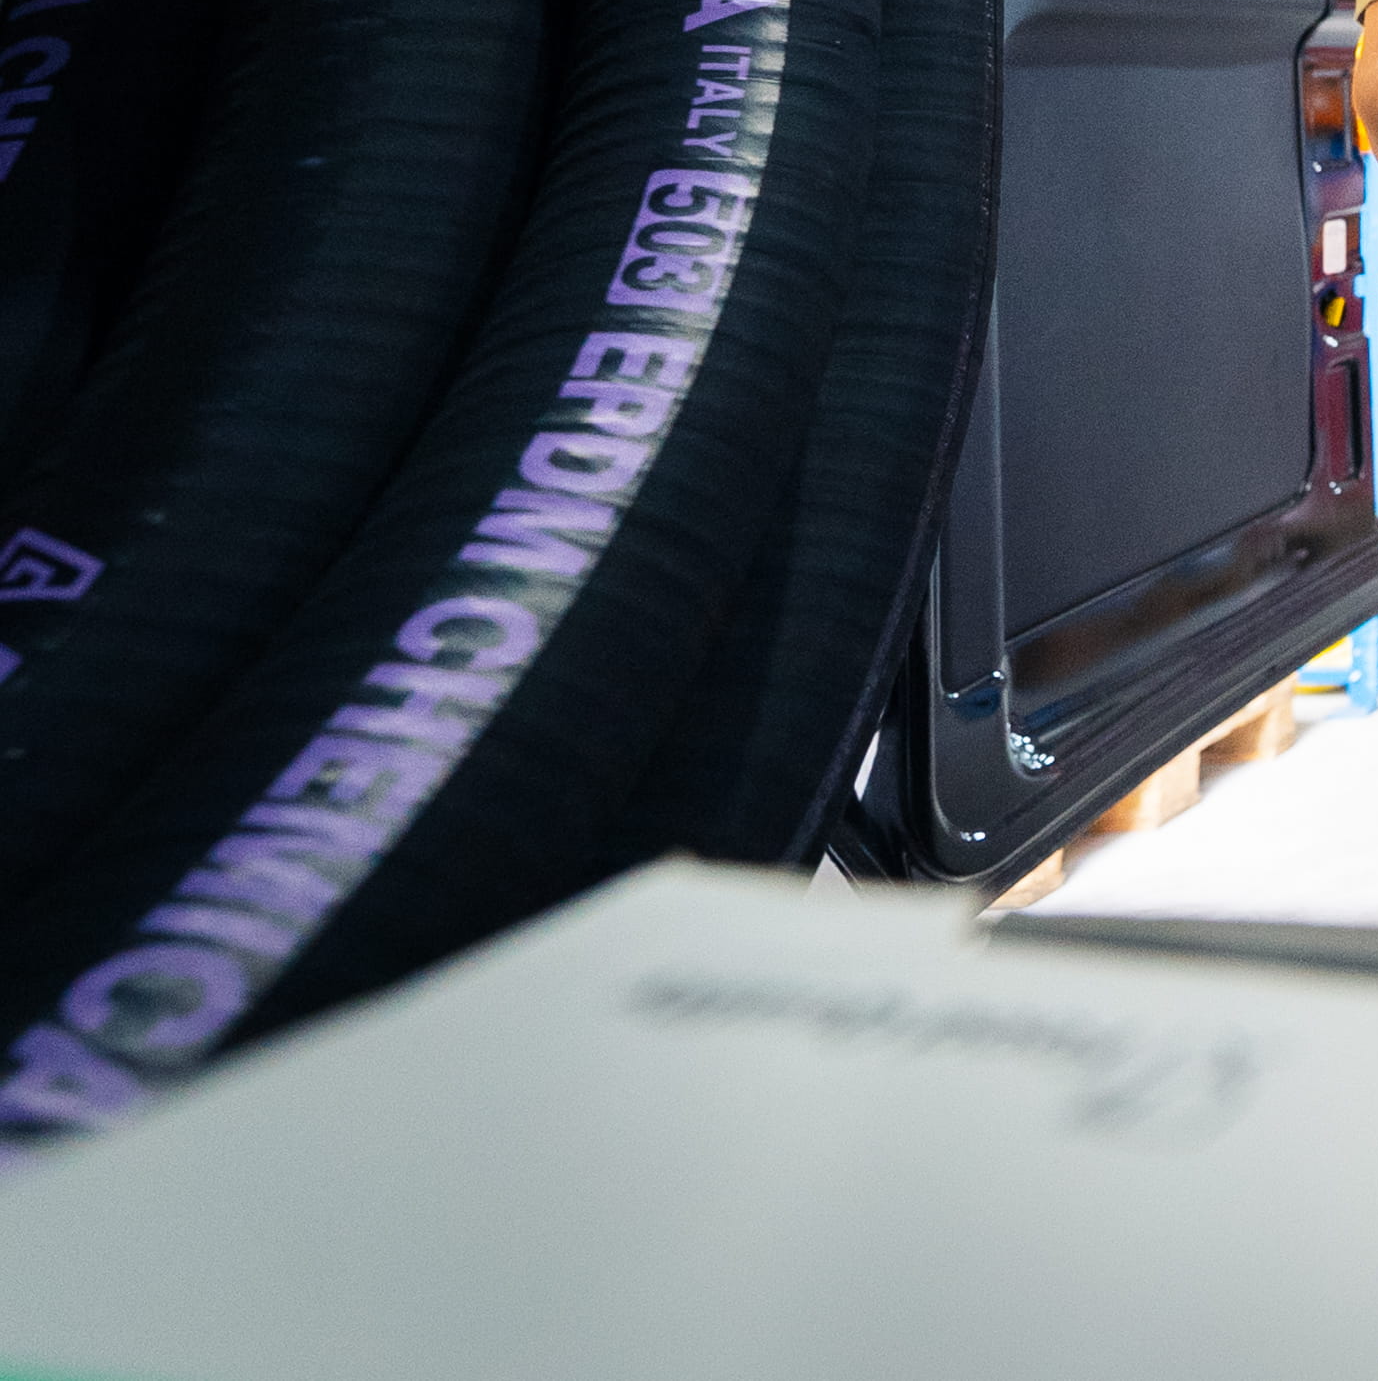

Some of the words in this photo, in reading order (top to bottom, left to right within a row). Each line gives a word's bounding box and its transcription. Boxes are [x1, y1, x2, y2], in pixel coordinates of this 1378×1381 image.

[683, 45, 752, 158] ITALY
[620, 175, 750, 301] 503
[457, 331, 699, 576] EPDM
[0, 596, 539, 1129] CHEMICA
